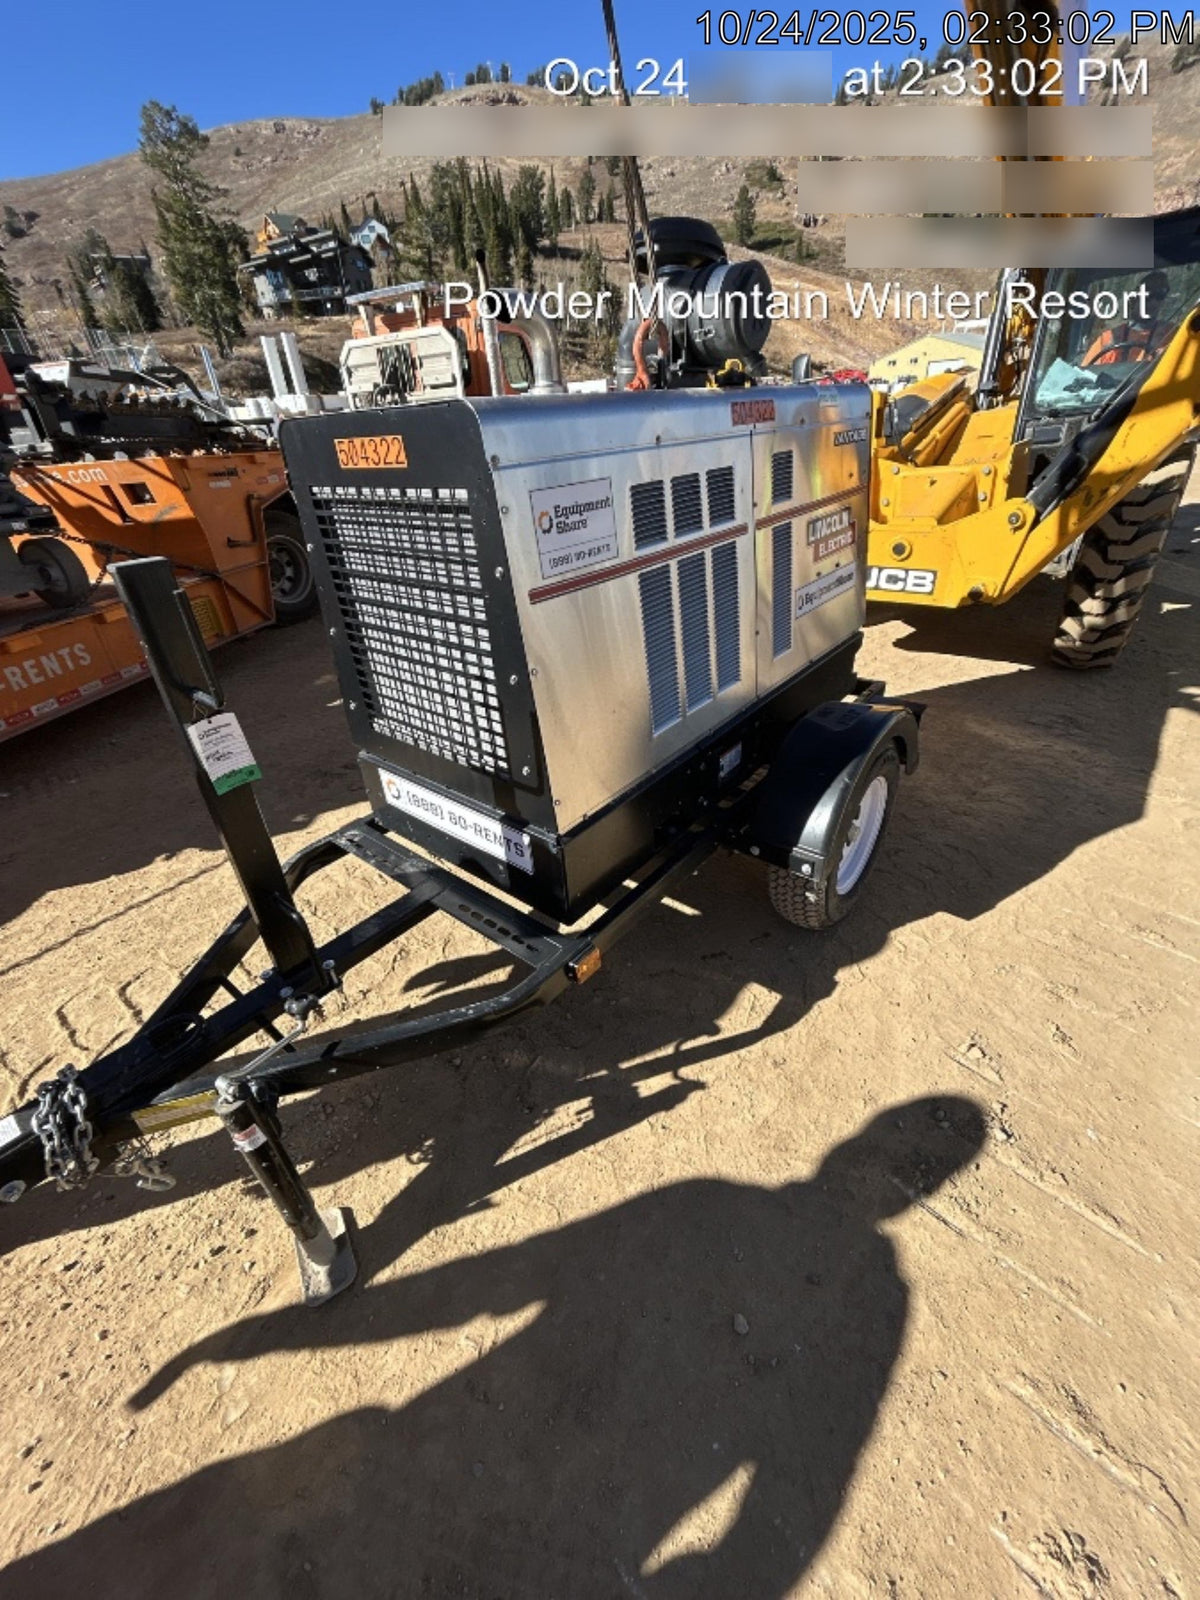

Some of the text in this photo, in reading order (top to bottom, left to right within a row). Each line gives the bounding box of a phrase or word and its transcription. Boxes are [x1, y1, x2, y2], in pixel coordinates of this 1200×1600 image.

[337, 437, 406, 466] 504322
[553, 495, 611, 519] Equipment
[556, 518, 588, 534] Share
[807, 509, 850, 541] LINCOLN
[818, 530, 854, 557] ELECTRIC
[865, 567, 934, 593] JCB
